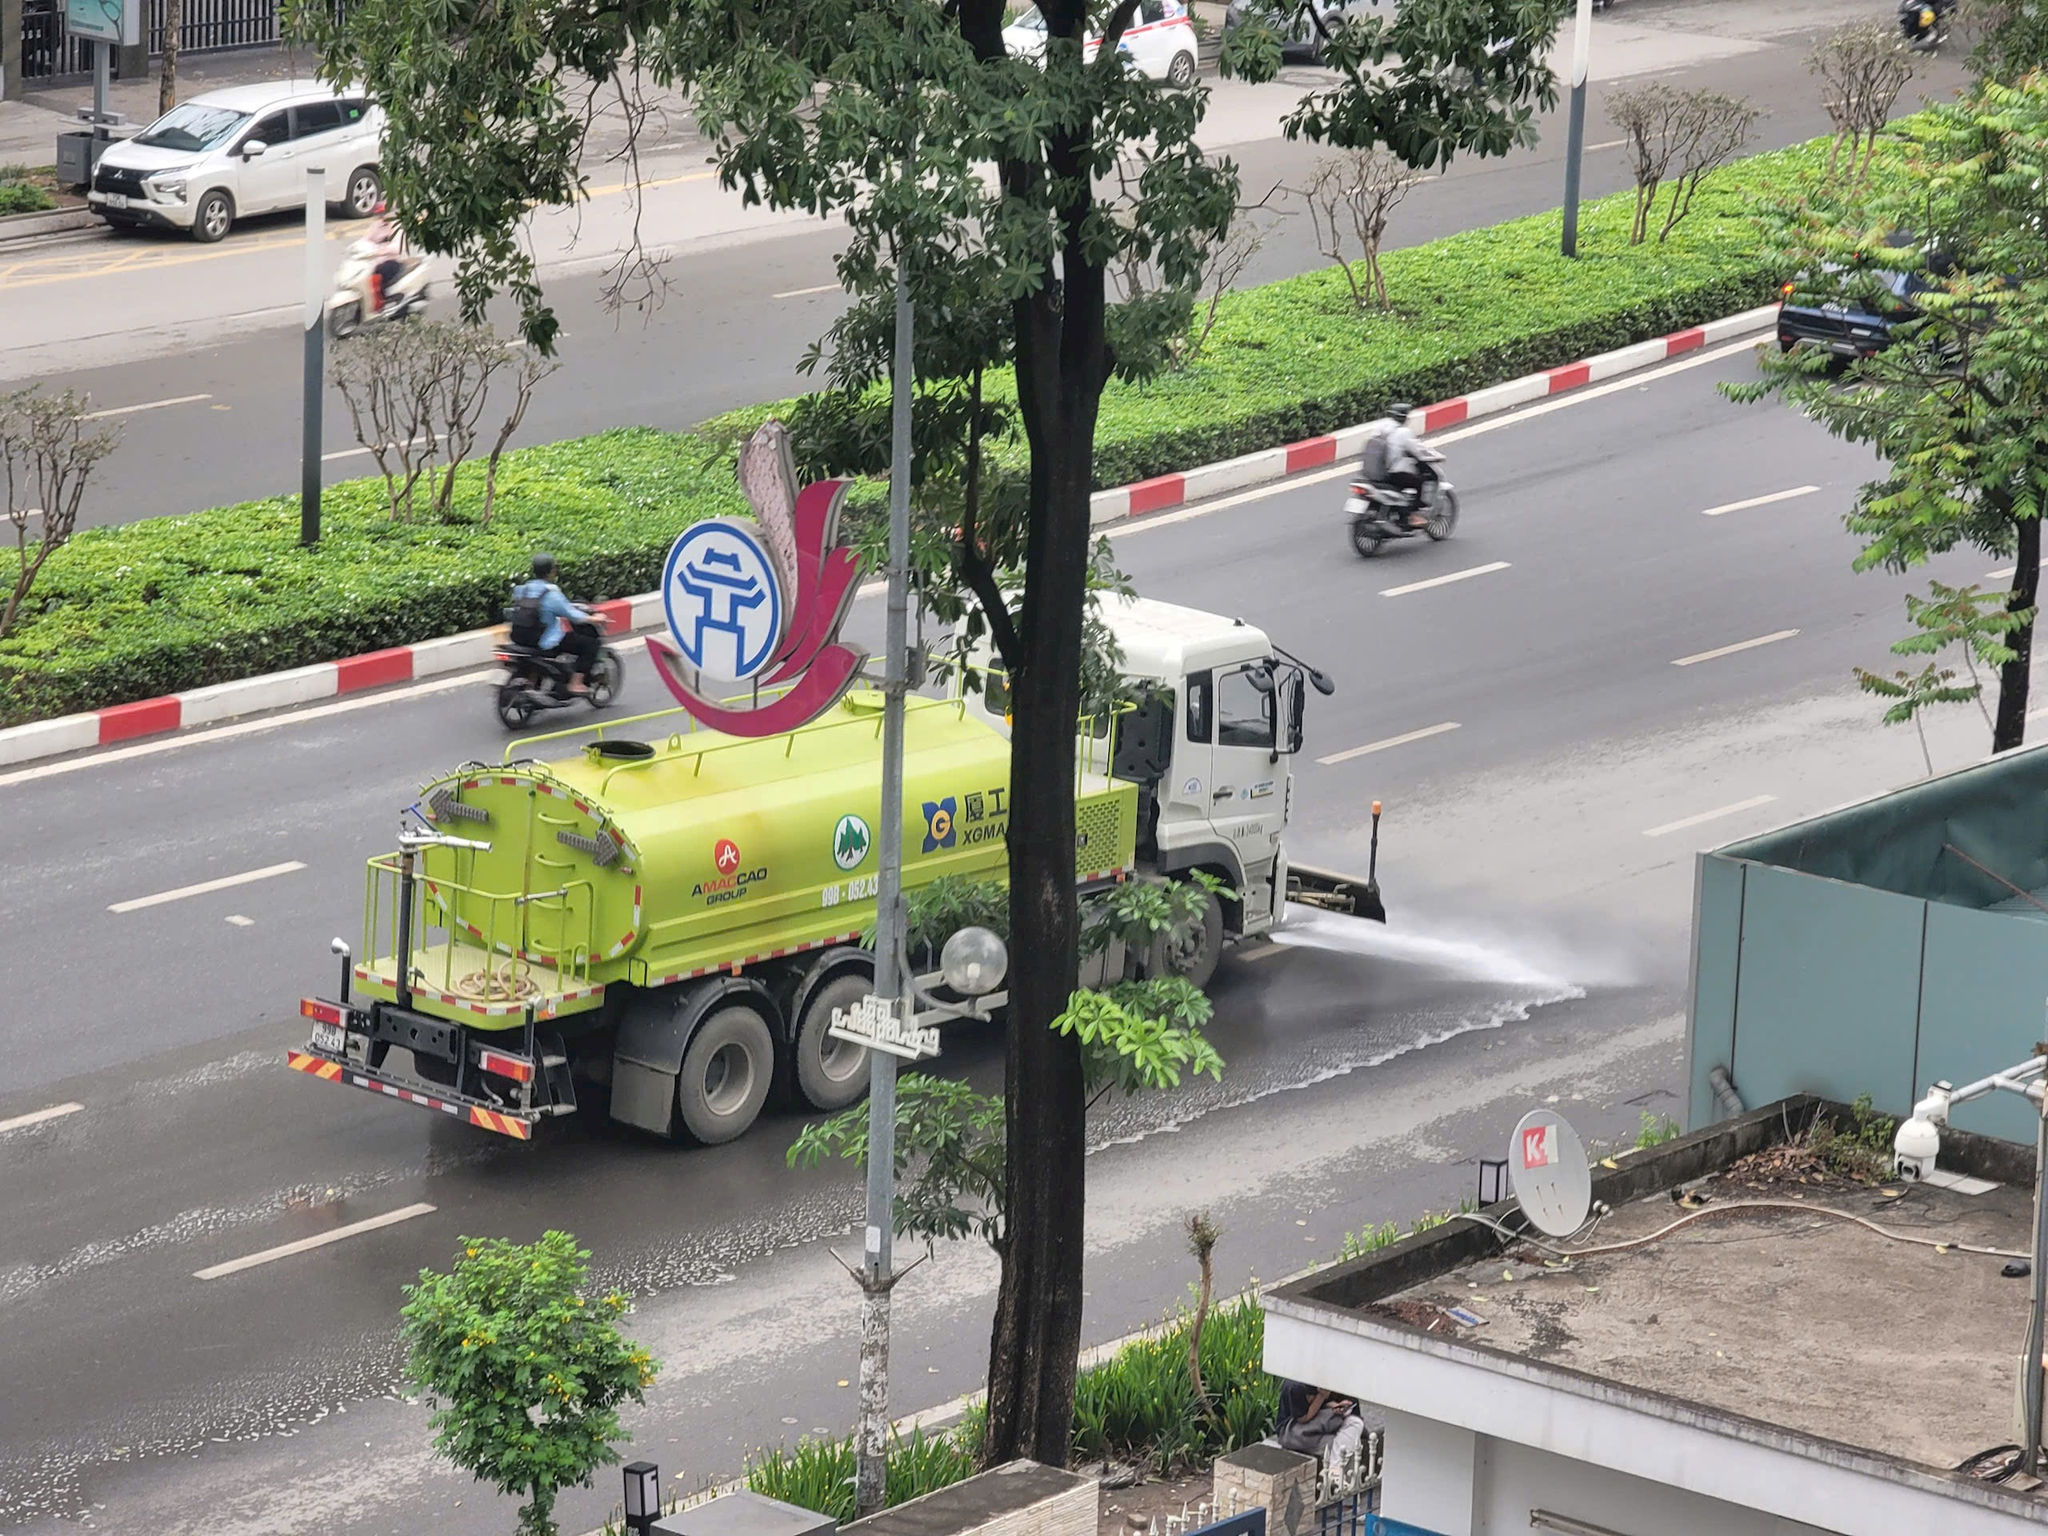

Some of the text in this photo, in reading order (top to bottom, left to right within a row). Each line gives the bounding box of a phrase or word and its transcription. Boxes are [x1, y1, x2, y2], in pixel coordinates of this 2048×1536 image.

[962, 822, 1005, 846] XGMA
[691, 867, 768, 897] AMACCAO
[706, 887, 747, 906] GROUP
